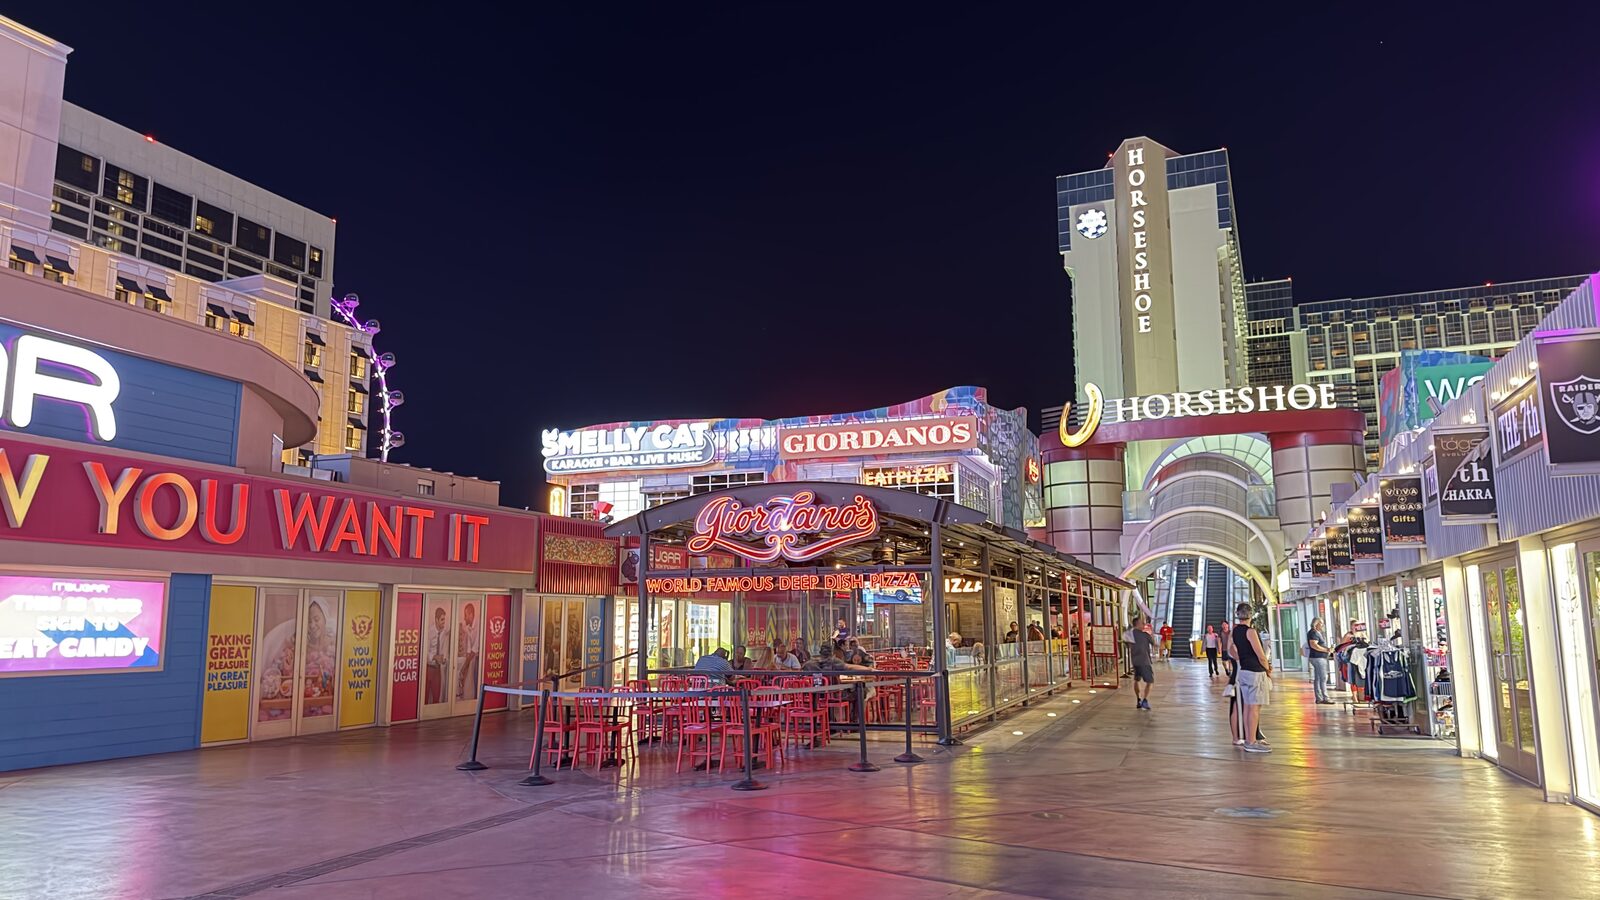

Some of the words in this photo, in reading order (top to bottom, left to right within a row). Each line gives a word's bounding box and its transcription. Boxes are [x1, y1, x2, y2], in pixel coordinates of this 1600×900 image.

[1127, 148, 1152, 333] HORSESHOE
[1113, 383, 1337, 423] HORSESHOE
[1499, 406, 1521, 454] THE
[1520, 394, 1540, 442] 7th
[541, 427, 649, 457] SMELLY
[652, 422, 710, 450] CAT
[783, 423, 970, 454] GIORDANO'S
[551, 458, 603, 470] KARAOKE
[610, 456, 632, 466] BAR
[639, 454, 665, 465] LIVE
[668, 451, 703, 463] MUSIC
[864, 471, 895, 486] EAT
[896, 466, 949, 484] PIZZA
[1385, 488, 1418, 496] VIVA
[82, 460, 249, 545] YOU
[273, 488, 434, 559] WANT
[448, 513, 490, 563] IT
[1384, 504, 1423, 512] VEGAS
[688, 491, 878, 561] Giordano's
[646, 578, 701, 593] WORLD
[707, 576, 773, 592] FAMOUS
[779, 575, 818, 591] DEEP
[825, 573, 864, 590] DISH
[870, 572, 921, 588] PIZZA
[210, 634, 251, 646] TAKING
[59, 637, 149, 658] CANDY
[352, 647, 369, 656] YOU
[491, 642, 503, 650] YOU
[210, 647, 249, 660] GREAT
[487, 652, 505, 660] KNOW
[208, 660, 249, 670] PLEASURE
[348, 657, 373, 668] KNOW
[490, 661, 502, 669] YOU
[208, 673, 218, 681] IN
[220, 671, 249, 680] GREAT
[351, 668, 368, 678] YOU
[487, 671, 503, 679] WANT
[207, 681, 248, 691] PLEASURE
[348, 679, 371, 689] WANT
[355, 691, 363, 700] IT
